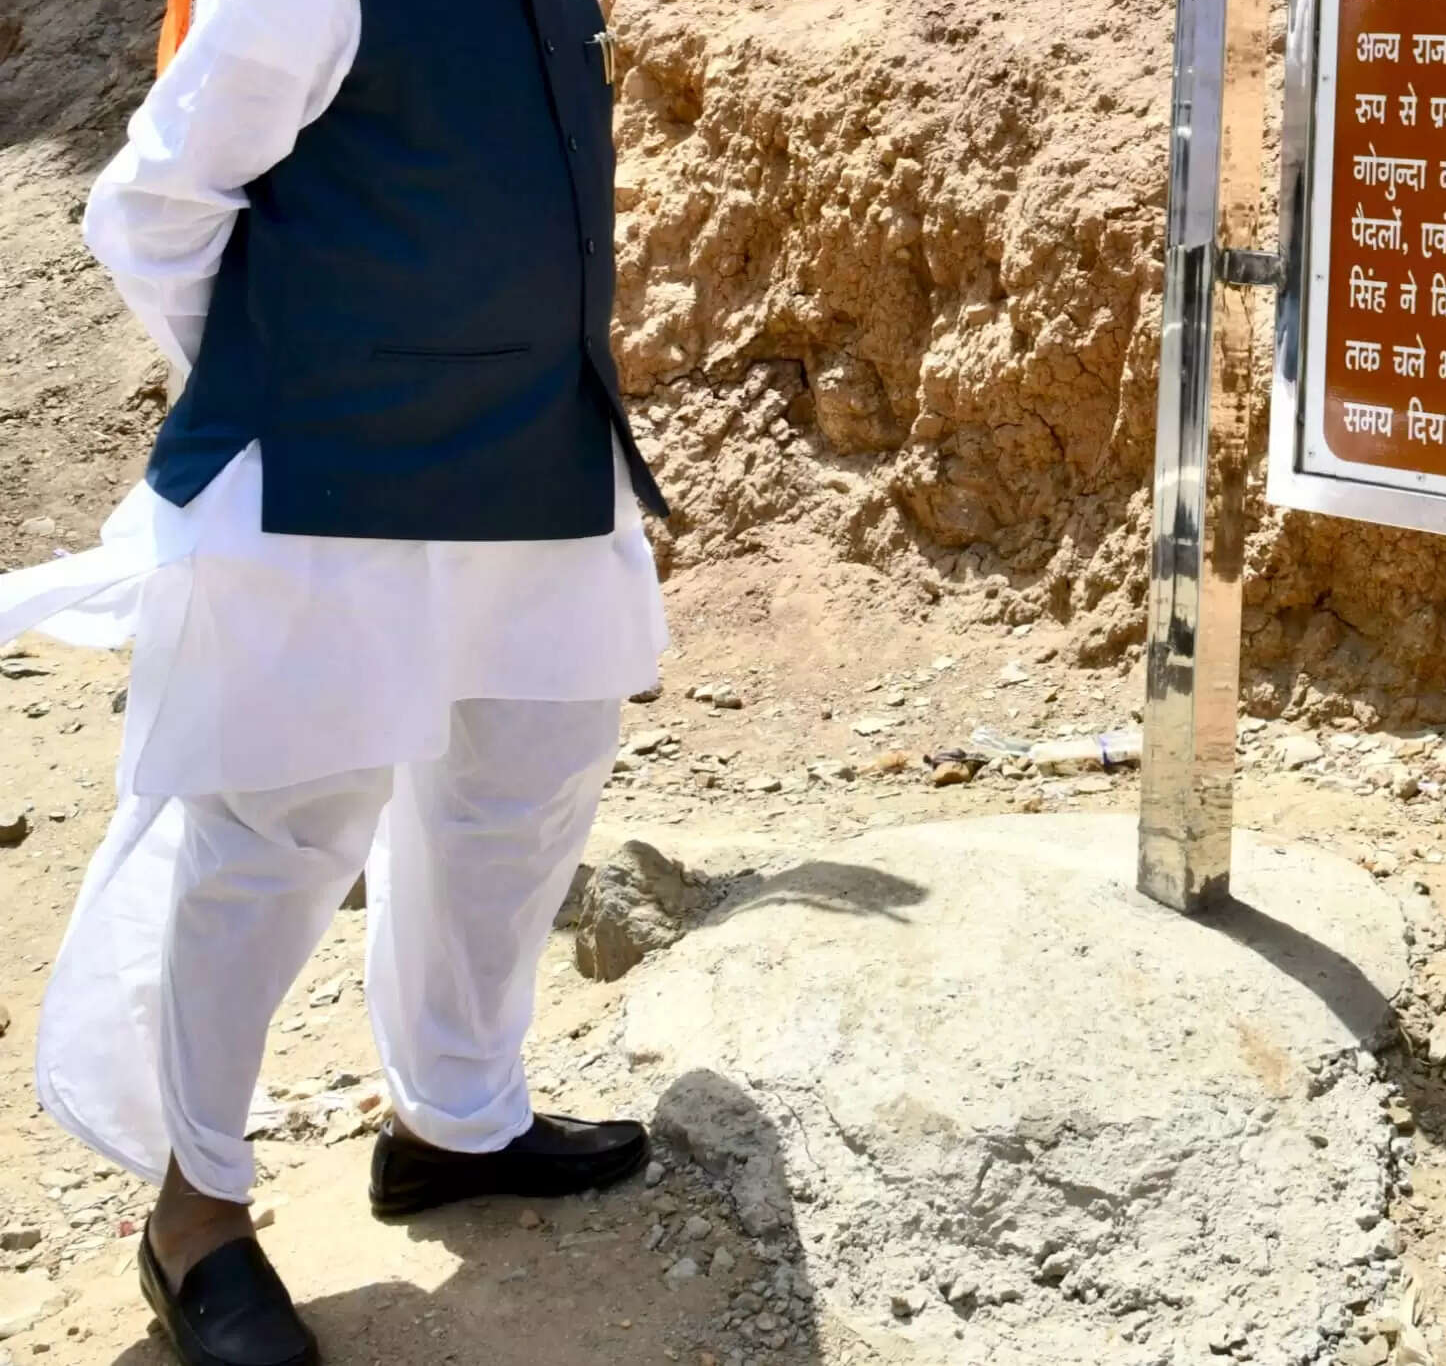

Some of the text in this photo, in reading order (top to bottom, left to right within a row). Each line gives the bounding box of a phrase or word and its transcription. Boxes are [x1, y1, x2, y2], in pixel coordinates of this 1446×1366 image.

[1352, 141, 1428, 202] गोगुन्दा
[1399, 269, 1418, 315] ने
[1344, 339, 1382, 372] तक
